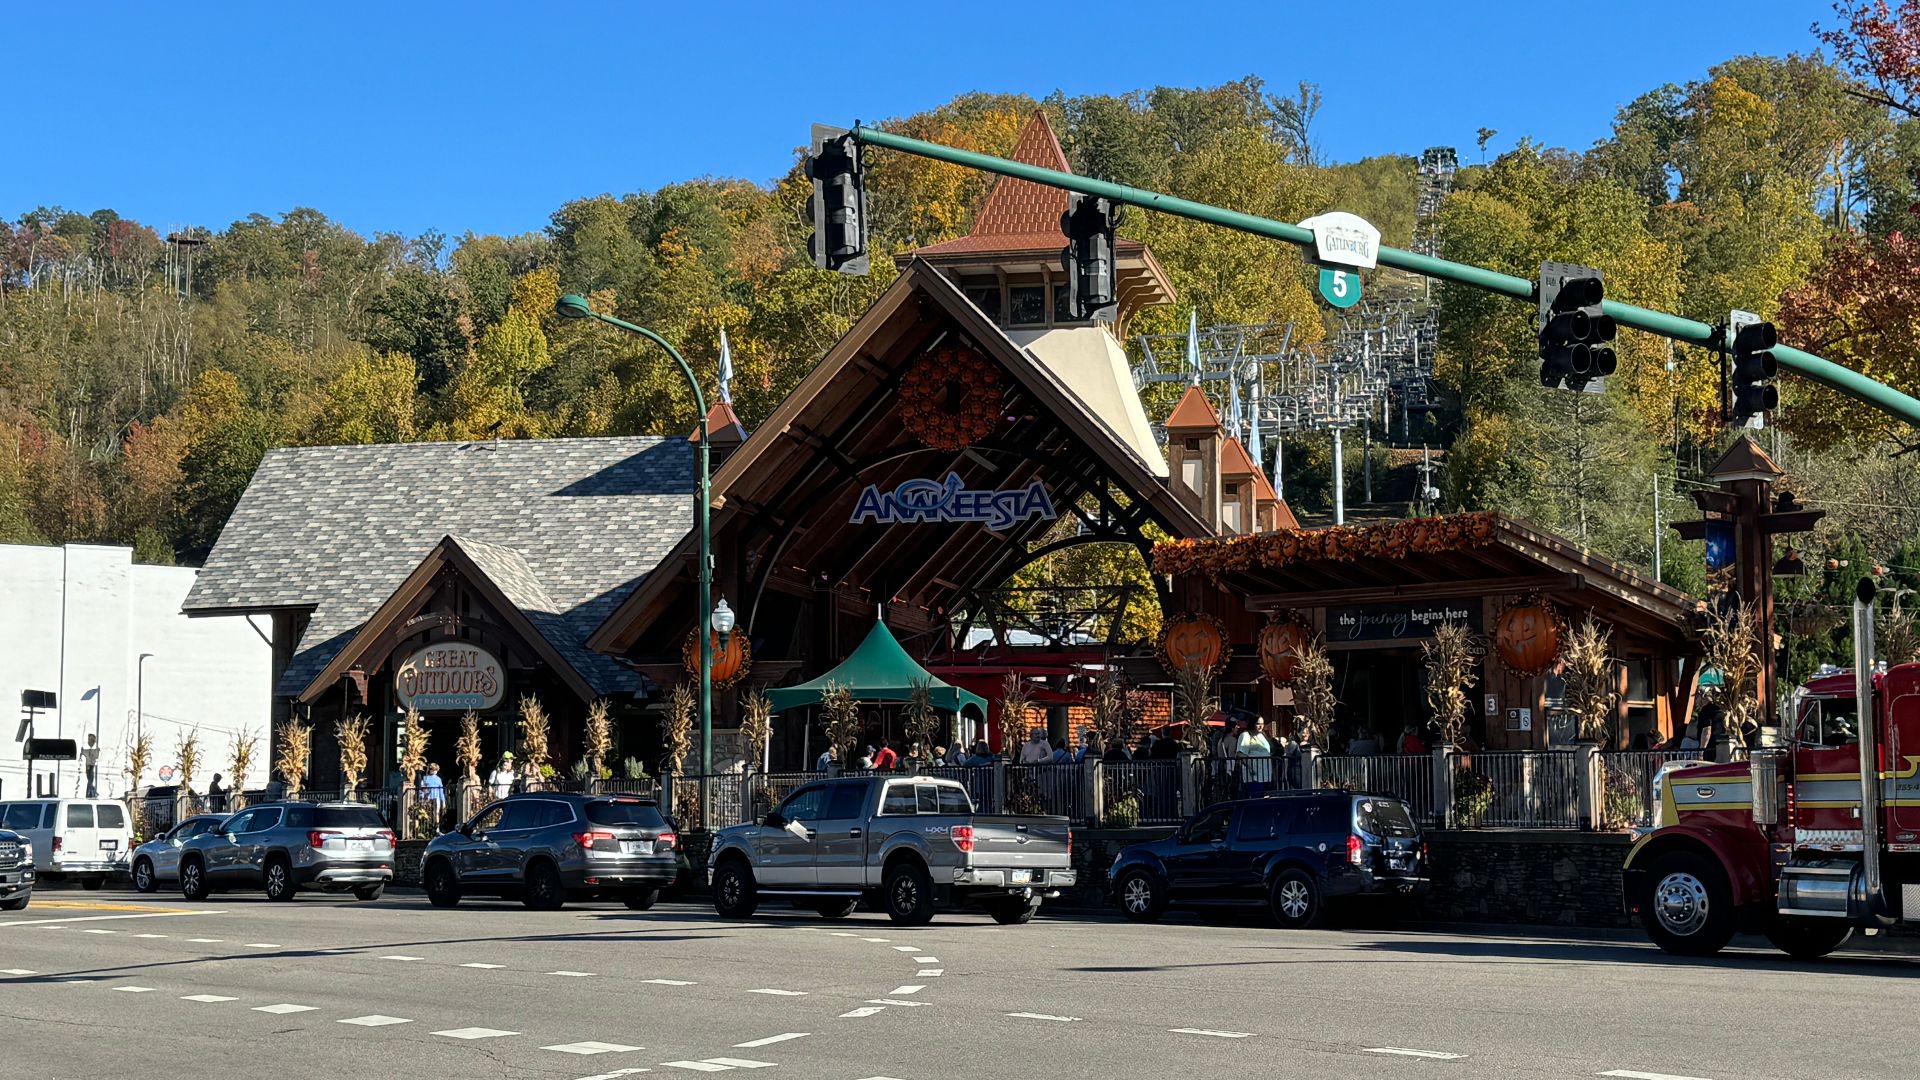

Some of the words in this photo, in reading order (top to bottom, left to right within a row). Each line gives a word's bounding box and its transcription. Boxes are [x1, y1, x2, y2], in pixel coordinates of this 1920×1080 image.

[1326, 234, 1369, 259] GATLINBURG
[1333, 270, 1347, 298] 5
[849, 480, 1058, 532] ANAKEESTA
[1339, 613, 1356, 625] the
[1349, 610, 1408, 640] journey
[1411, 608, 1443, 625] begins
[1445, 607, 1468, 620] here
[425, 650, 479, 668] GREAT
[403, 666, 498, 697] OUTDOORS
[1488, 698, 1496, 711] 3
